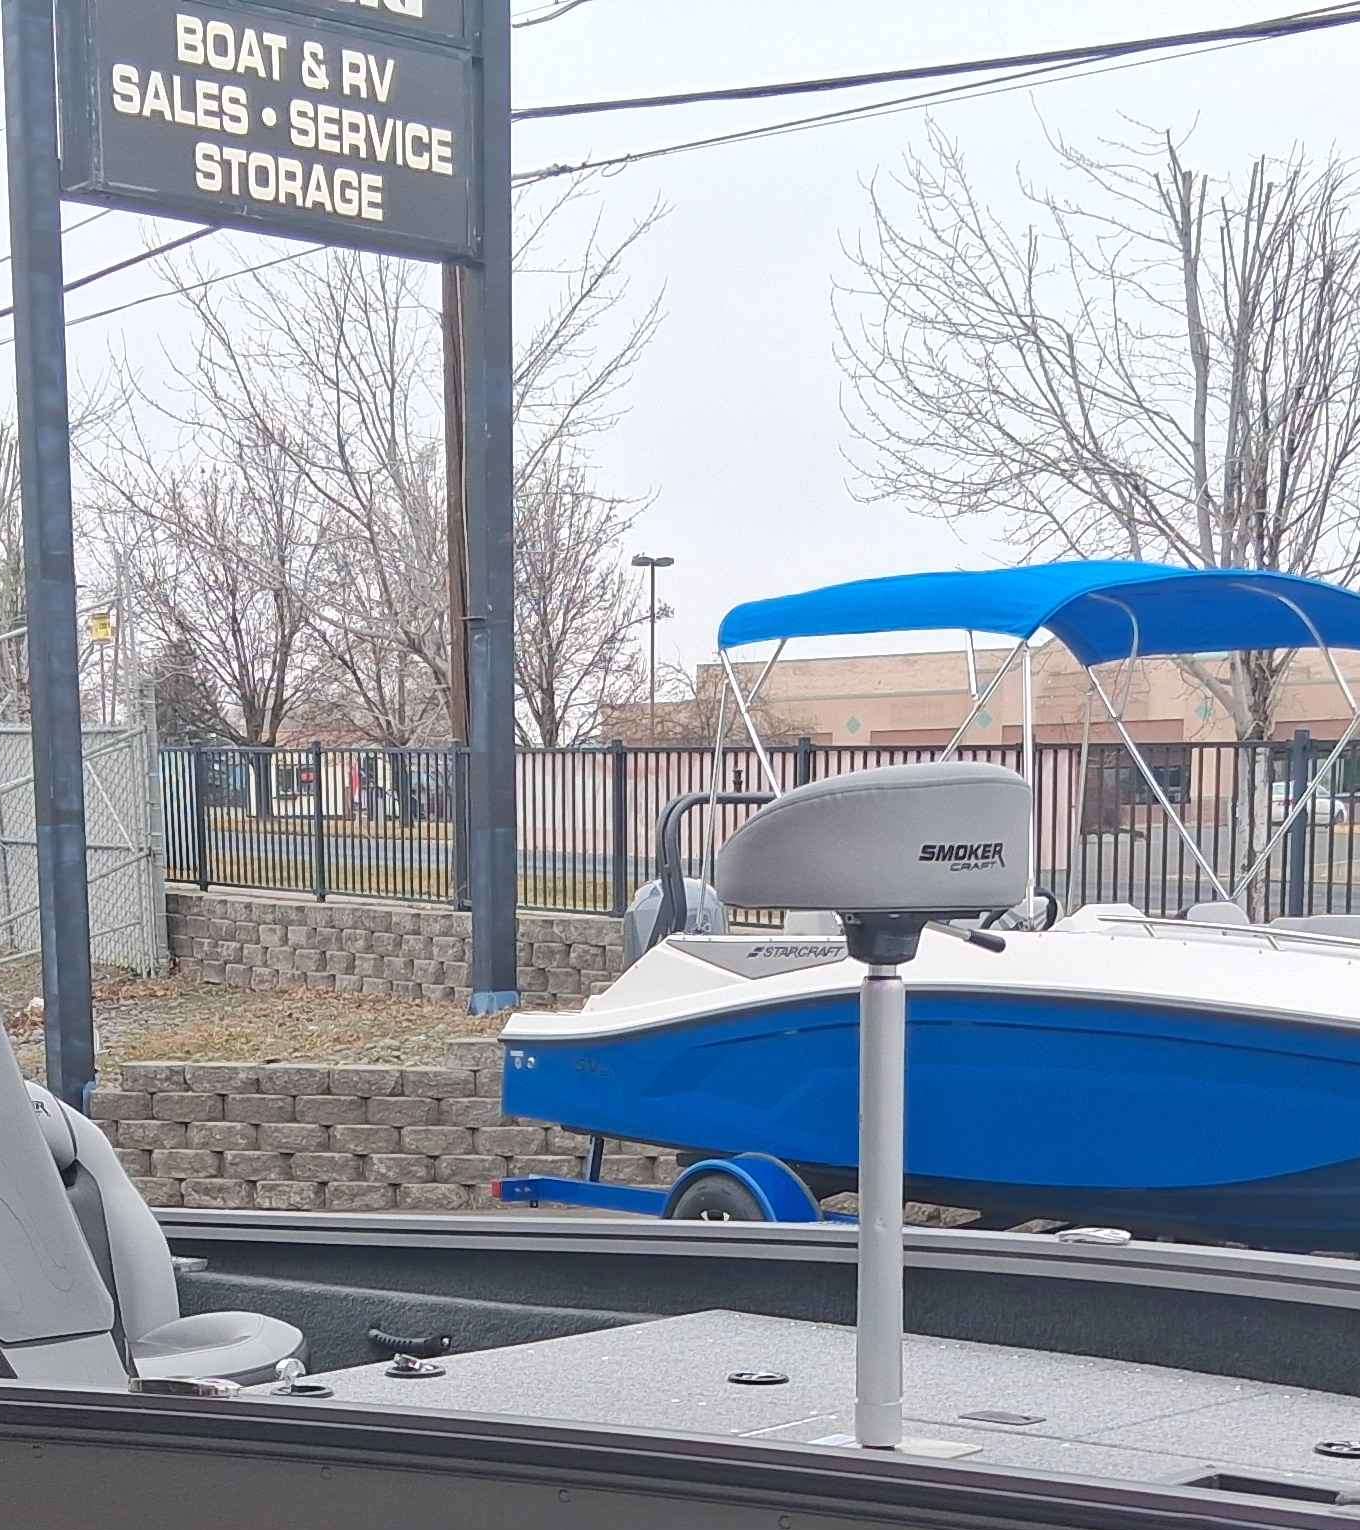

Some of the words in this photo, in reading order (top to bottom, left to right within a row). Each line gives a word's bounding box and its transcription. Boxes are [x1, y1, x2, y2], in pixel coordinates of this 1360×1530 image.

[176, 13, 288, 82] BOAT
[301, 40, 330, 90] &
[342, 49, 395, 103] RV
[112, 63, 249, 136] SALES
[289, 99, 455, 177] SERVICE
[194, 142, 385, 222] STORAGE
[918, 842, 1006, 868] SMOKER
[950, 861, 998, 872] CRAFT
[763, 946, 845, 958] STARCRAFT
